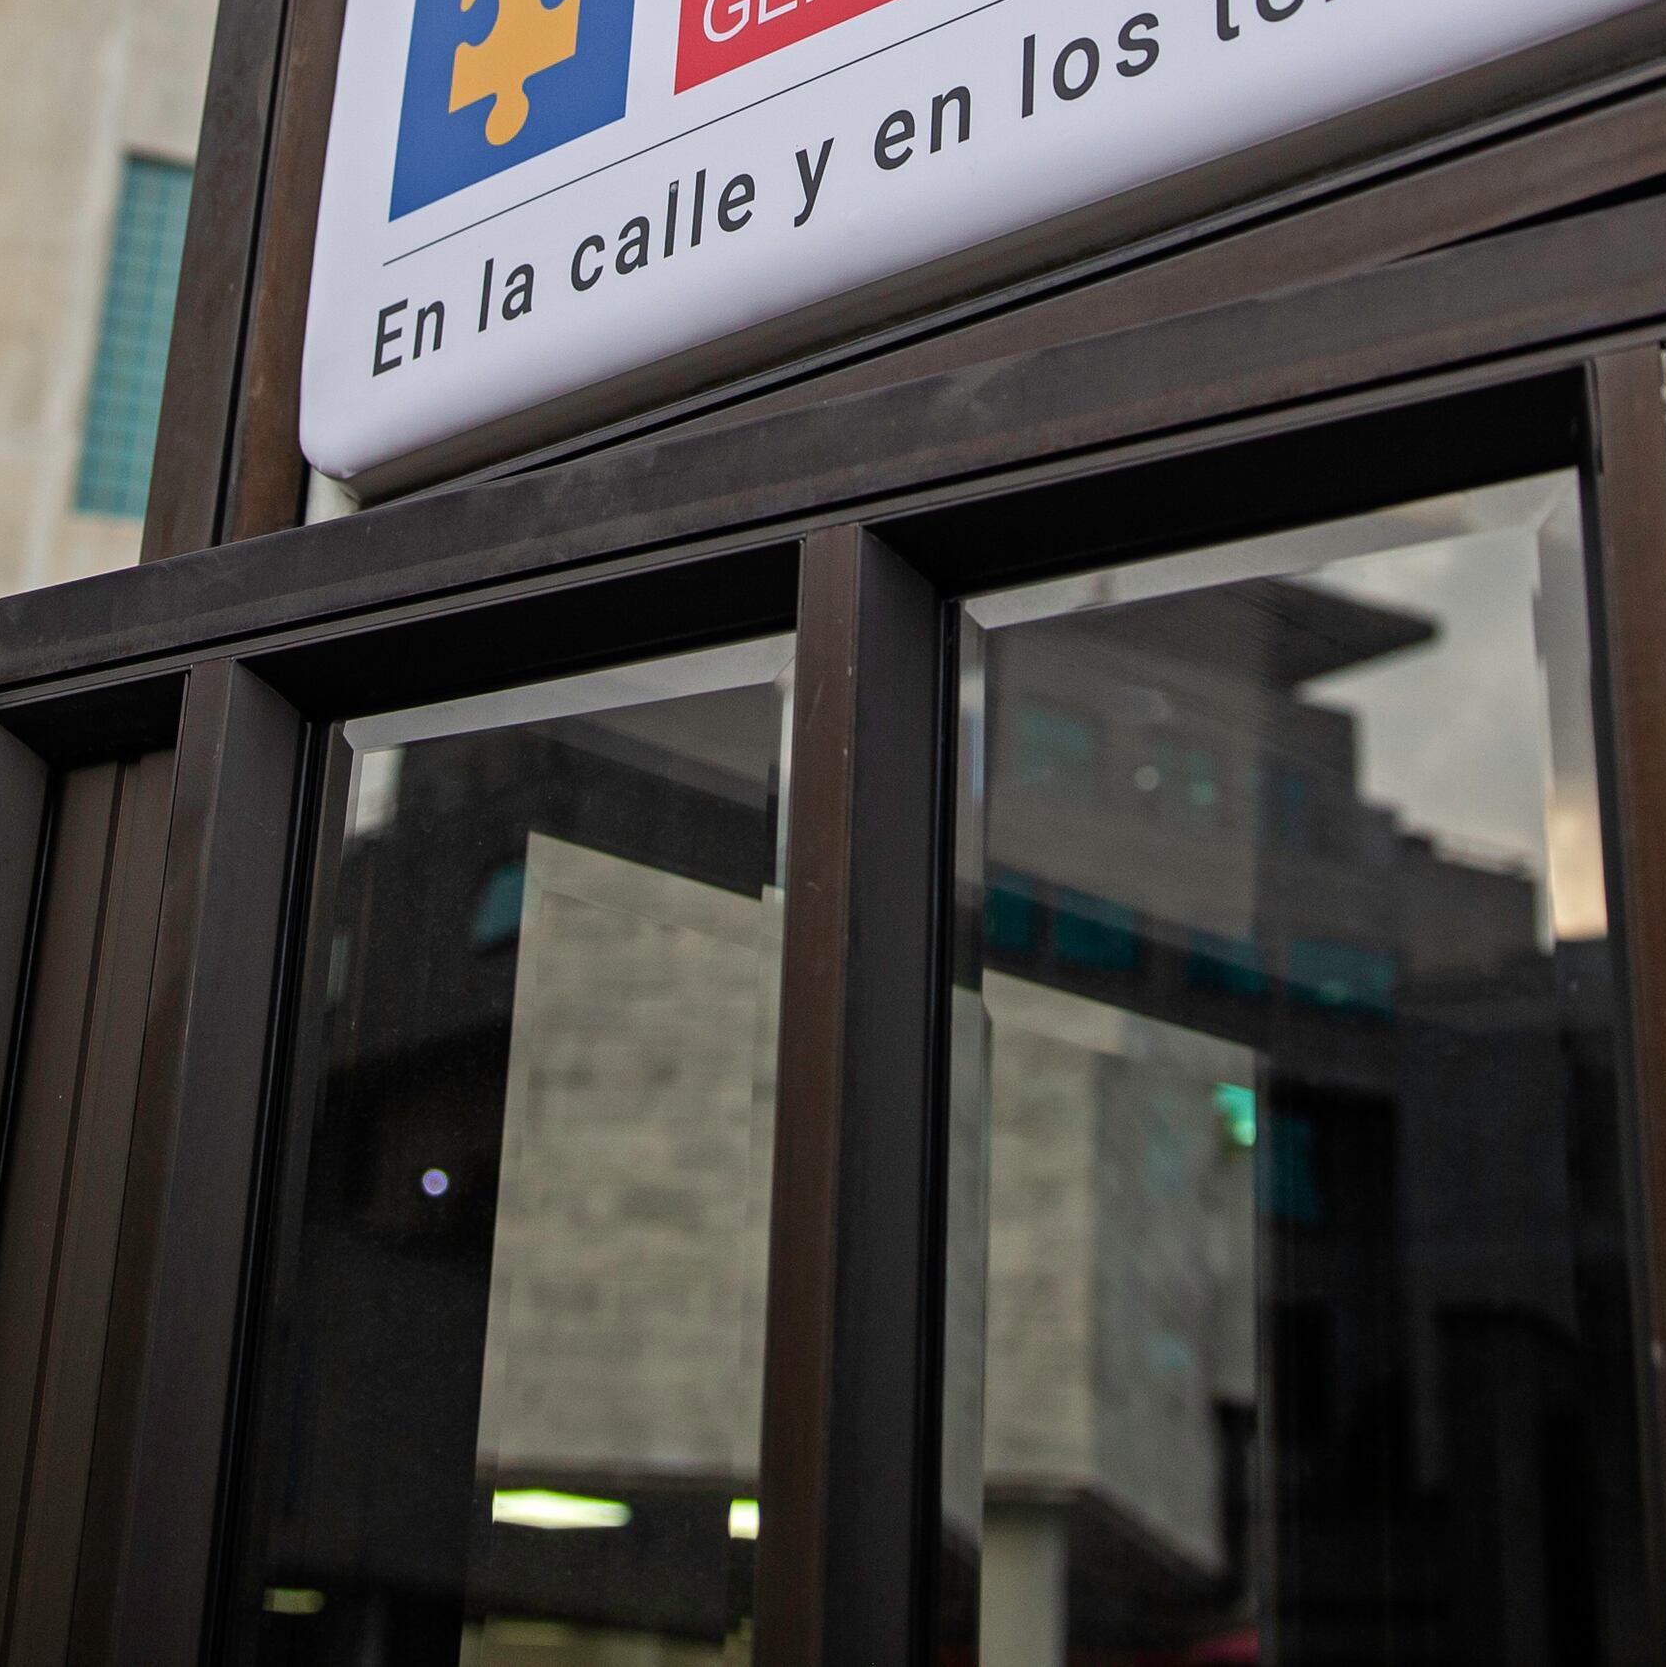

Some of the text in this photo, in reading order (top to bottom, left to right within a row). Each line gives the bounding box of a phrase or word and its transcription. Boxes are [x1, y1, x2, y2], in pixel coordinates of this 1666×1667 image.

[370, 297, 446, 380] En
[476, 257, 536, 334] la
[569, 167, 757, 293] calle
[792, 136, 836, 229] y
[873, 84, 972, 172] en
[1020, 11, 1161, 121] los
